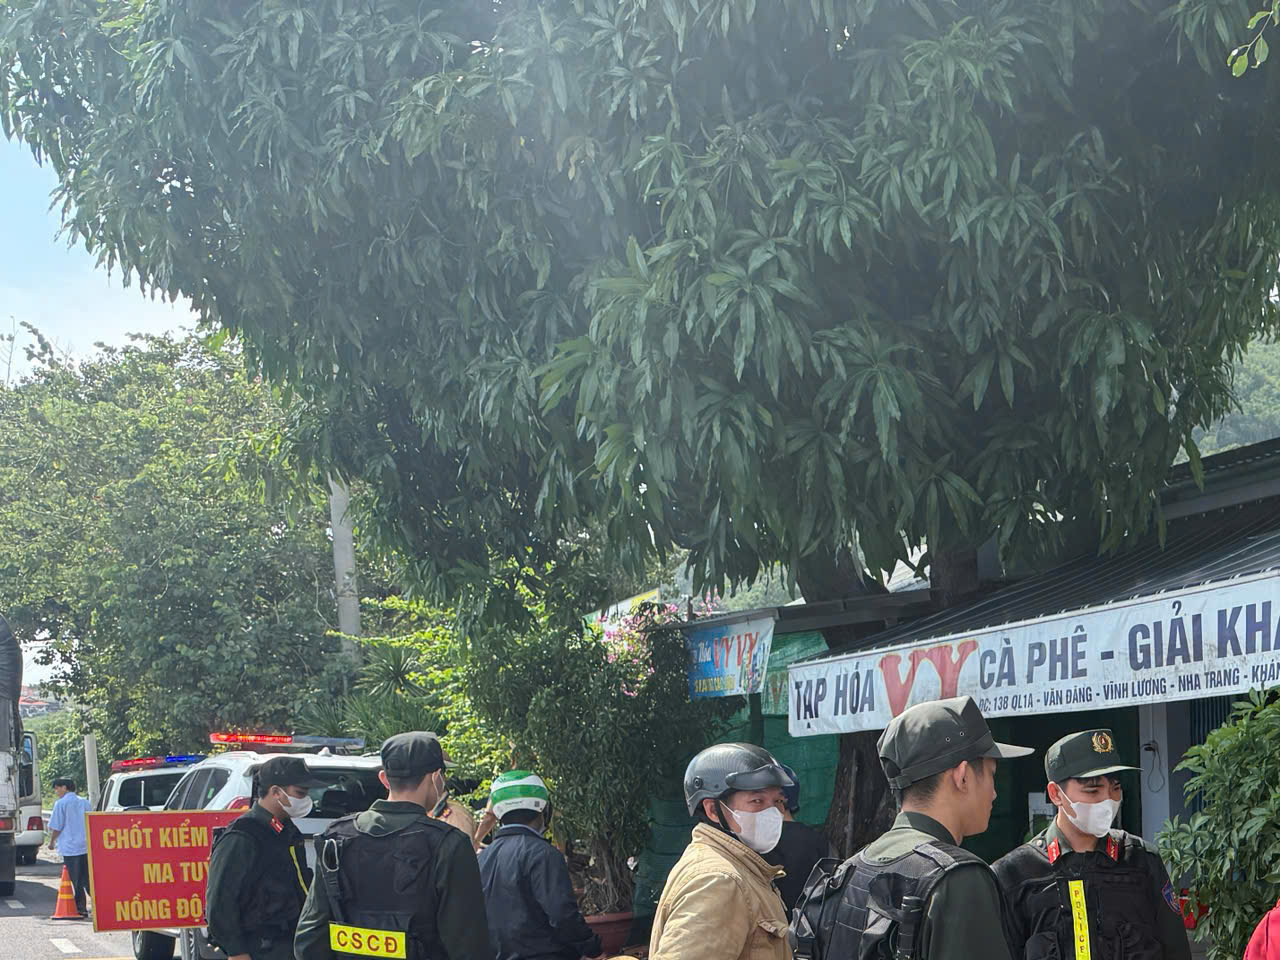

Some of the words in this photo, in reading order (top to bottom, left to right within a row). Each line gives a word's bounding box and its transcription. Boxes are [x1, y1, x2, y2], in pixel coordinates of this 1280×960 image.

[795, 677, 827, 728] TẠP
[834, 662, 875, 716] HÓA
[879, 640, 979, 717] VY
[979, 637, 1016, 690] CÀ
[1027, 625, 1087, 684] PHÊ
[1128, 600, 1203, 671] GIẢI
[994, 696, 1009, 711] 138
[1011, 693, 1033, 709] QL1A
[1103, 681, 1128, 700] VĨNH
[1132, 678, 1167, 698] LƯƠNG
[1178, 673, 1201, 692] NHA
[1204, 668, 1240, 689] TRANG
[103, 820, 153, 849] CHỐT
[159, 818, 208, 848] KIỂM
[143, 862, 174, 883] MA
[115, 892, 171, 922] NỒNG
[176, 893, 202, 922] ĐỘ
[1073, 889, 1086, 954] POLICE
[336, 929, 398, 953] CSCĐ
